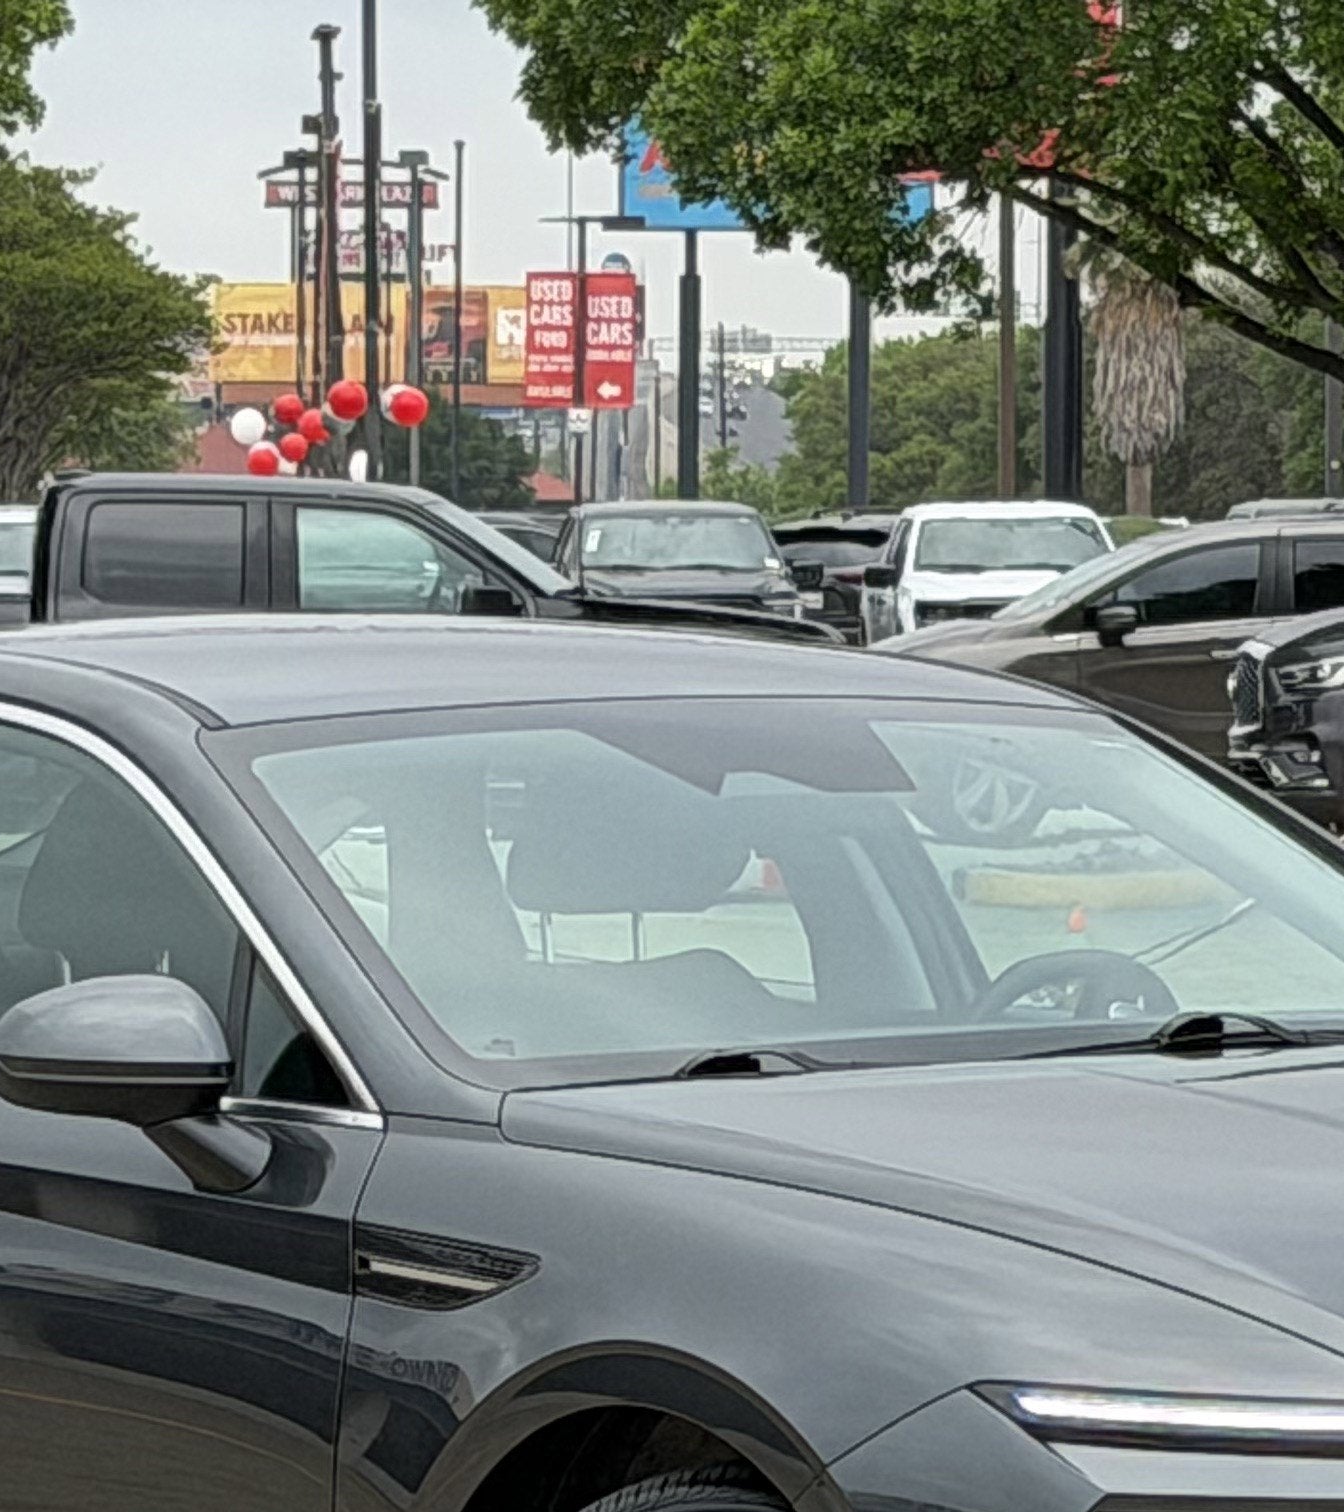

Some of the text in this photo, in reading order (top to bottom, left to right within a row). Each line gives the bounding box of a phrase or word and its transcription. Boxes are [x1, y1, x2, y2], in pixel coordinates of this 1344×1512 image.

[530, 279, 573, 301] USED
[530, 304, 573, 326] CARS
[587, 296, 633, 319] USED
[586, 321, 633, 345] CARS
